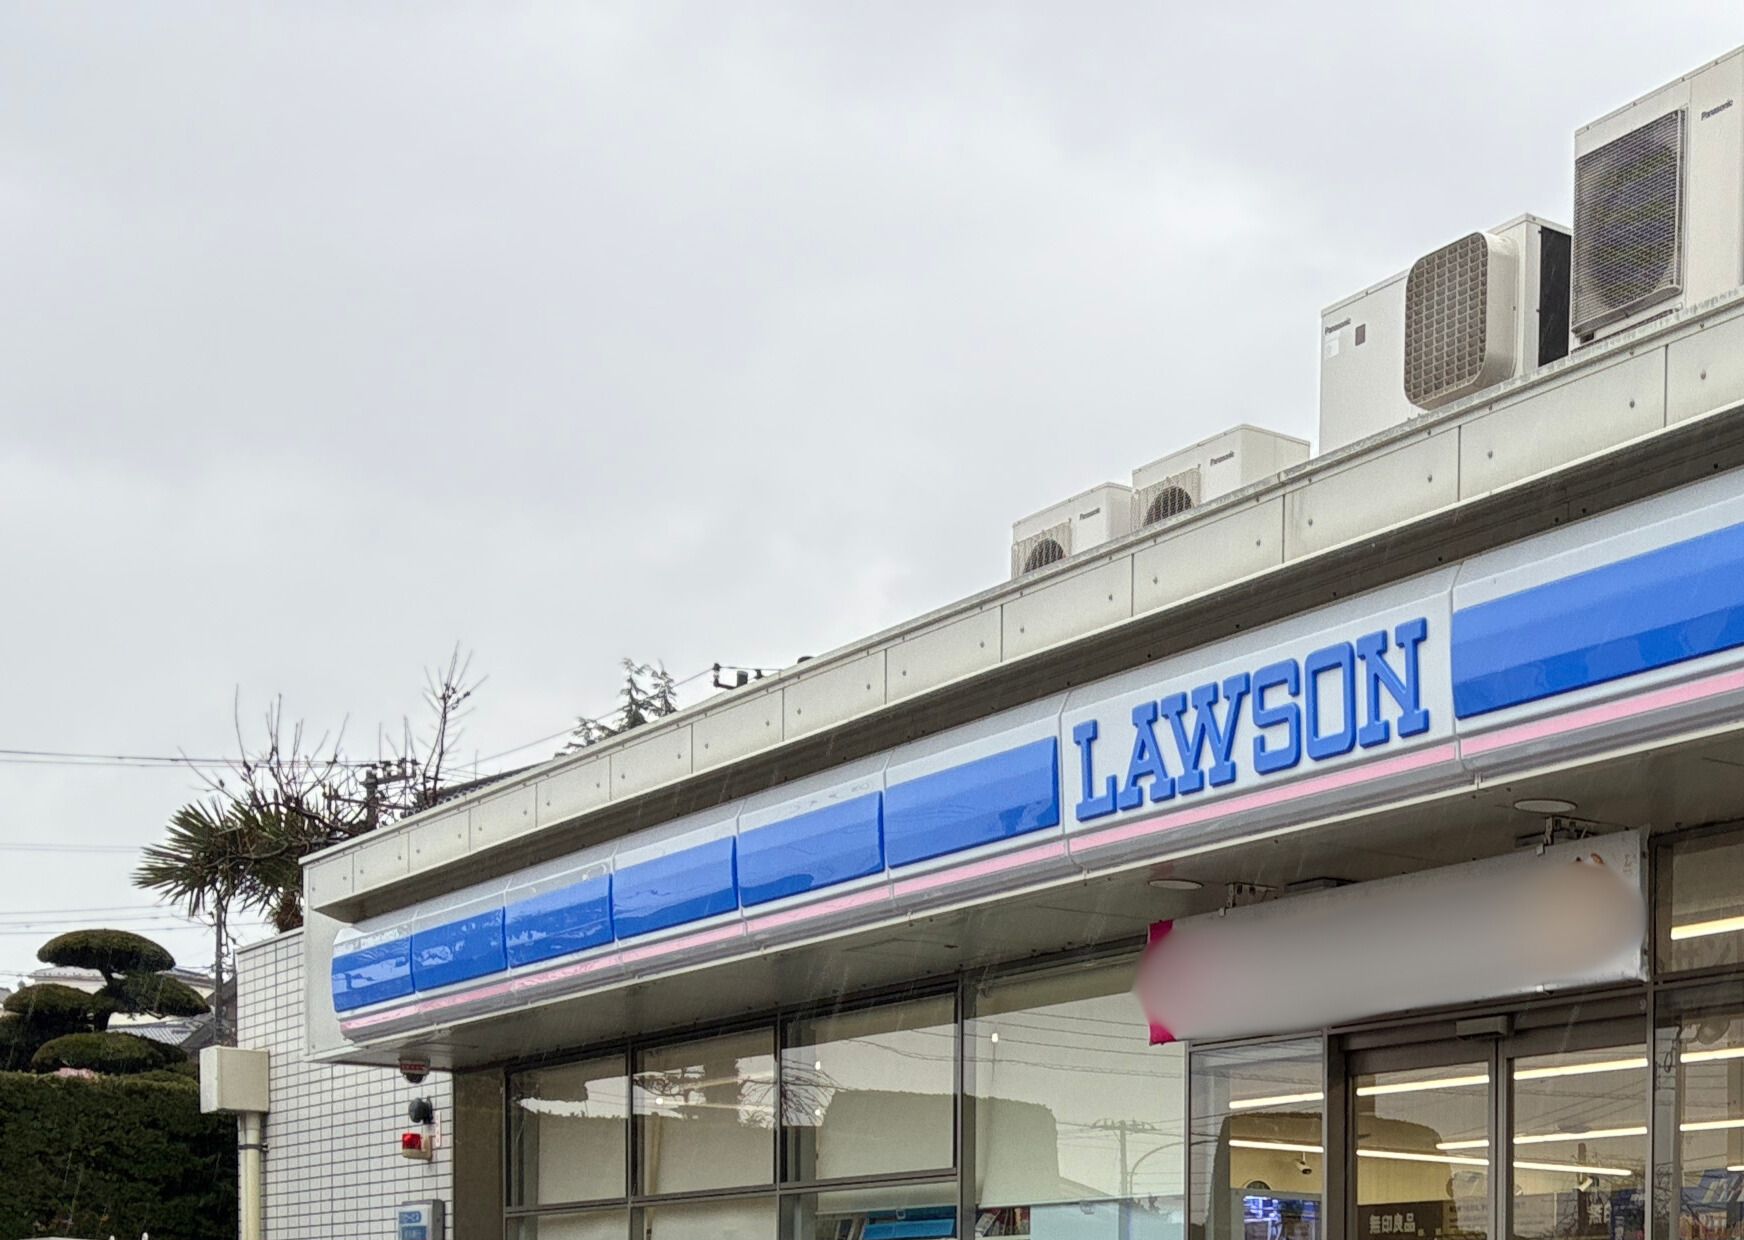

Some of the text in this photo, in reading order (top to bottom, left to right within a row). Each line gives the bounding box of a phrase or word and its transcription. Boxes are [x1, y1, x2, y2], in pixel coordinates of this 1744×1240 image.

[1073, 617, 1430, 822] LAWSON
[1369, 1213, 1416, 1233] 無印良品
